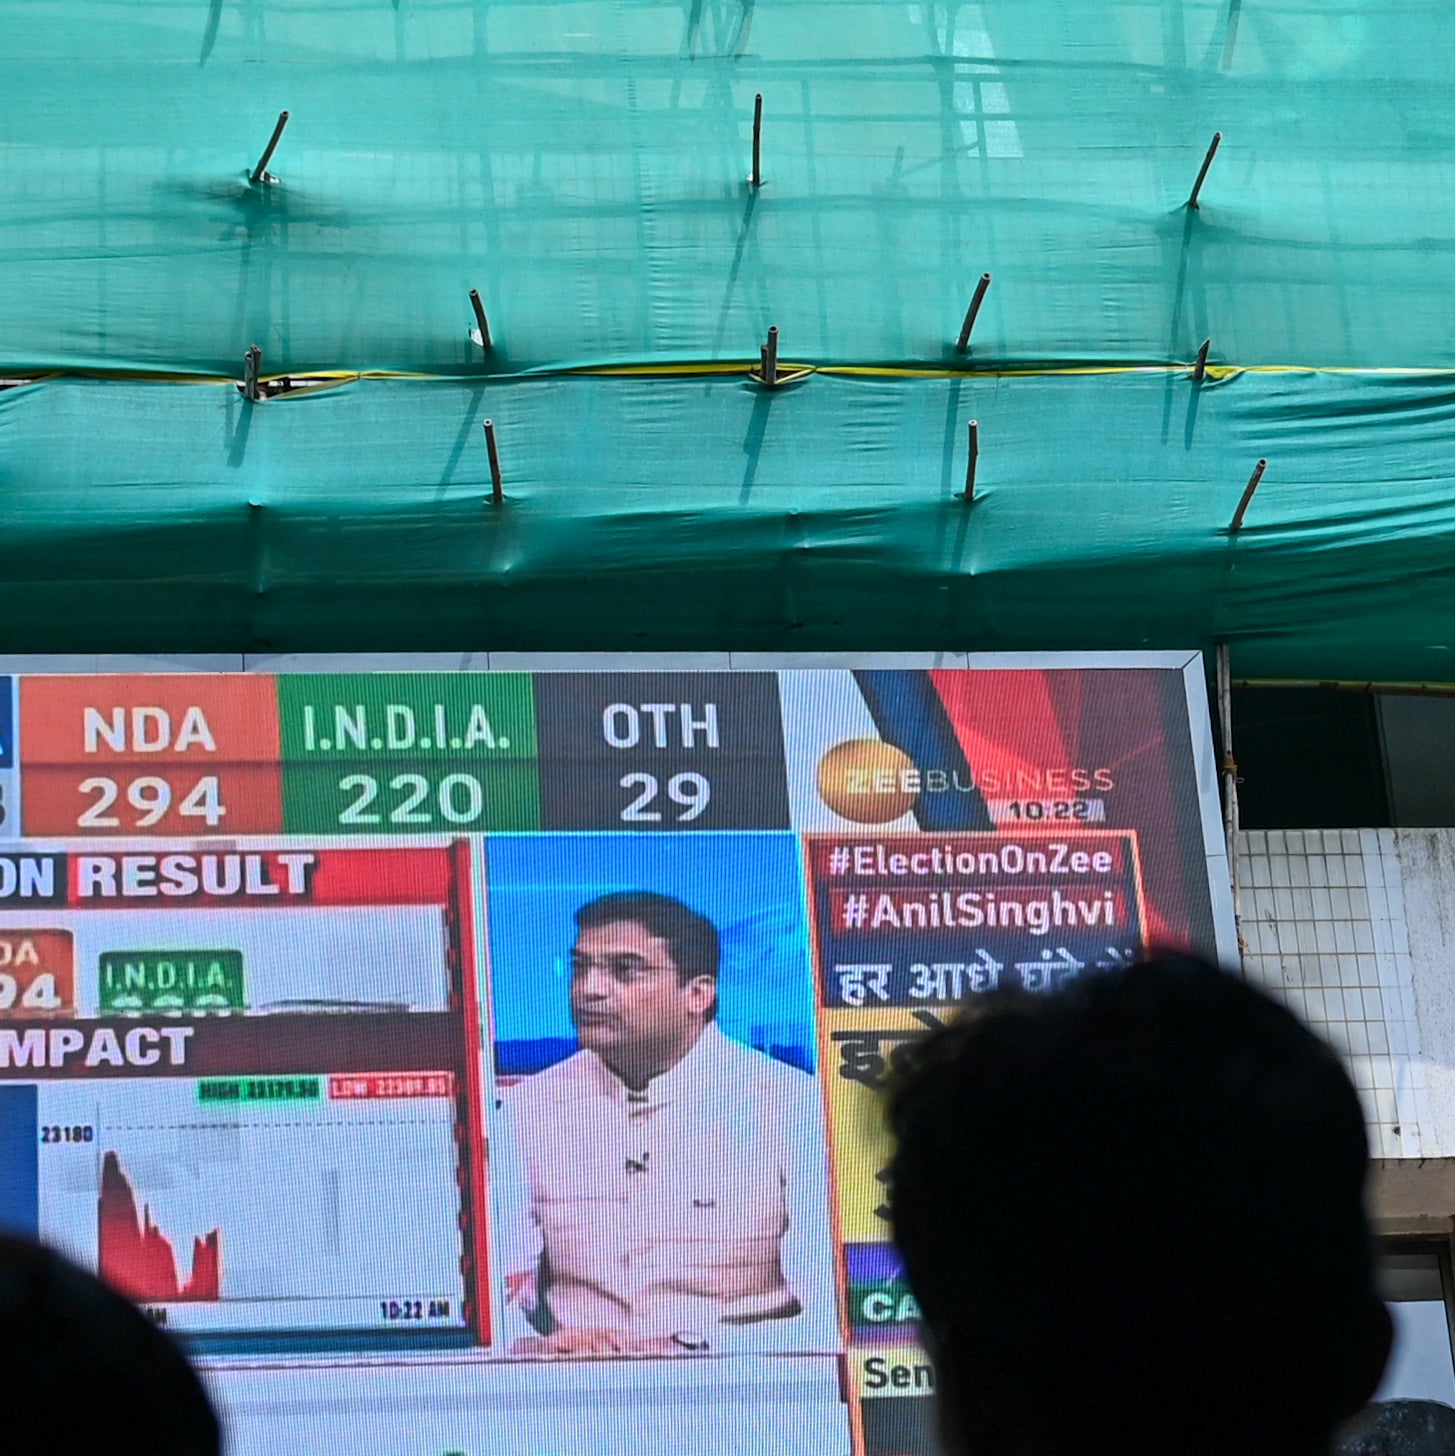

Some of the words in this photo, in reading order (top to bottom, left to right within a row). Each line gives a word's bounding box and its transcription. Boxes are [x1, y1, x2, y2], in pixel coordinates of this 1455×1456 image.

[84, 706, 217, 752] NDA
[303, 704, 511, 751] I.N.D.I.A.
[602, 702, 720, 749] OTH
[76, 776, 227, 828] 294
[338, 773, 483, 825] 220
[619, 772, 712, 822] 29
[76, 853, 316, 899] RESULT
[829, 843, 1113, 876] #ElectionOnZee
[842, 890, 1115, 936] #AnilSinghvi
[106, 961, 234, 989] I.N.D.I.A.
[835, 963, 893, 1006] हर
[41, 1125, 94, 1143] 23180
